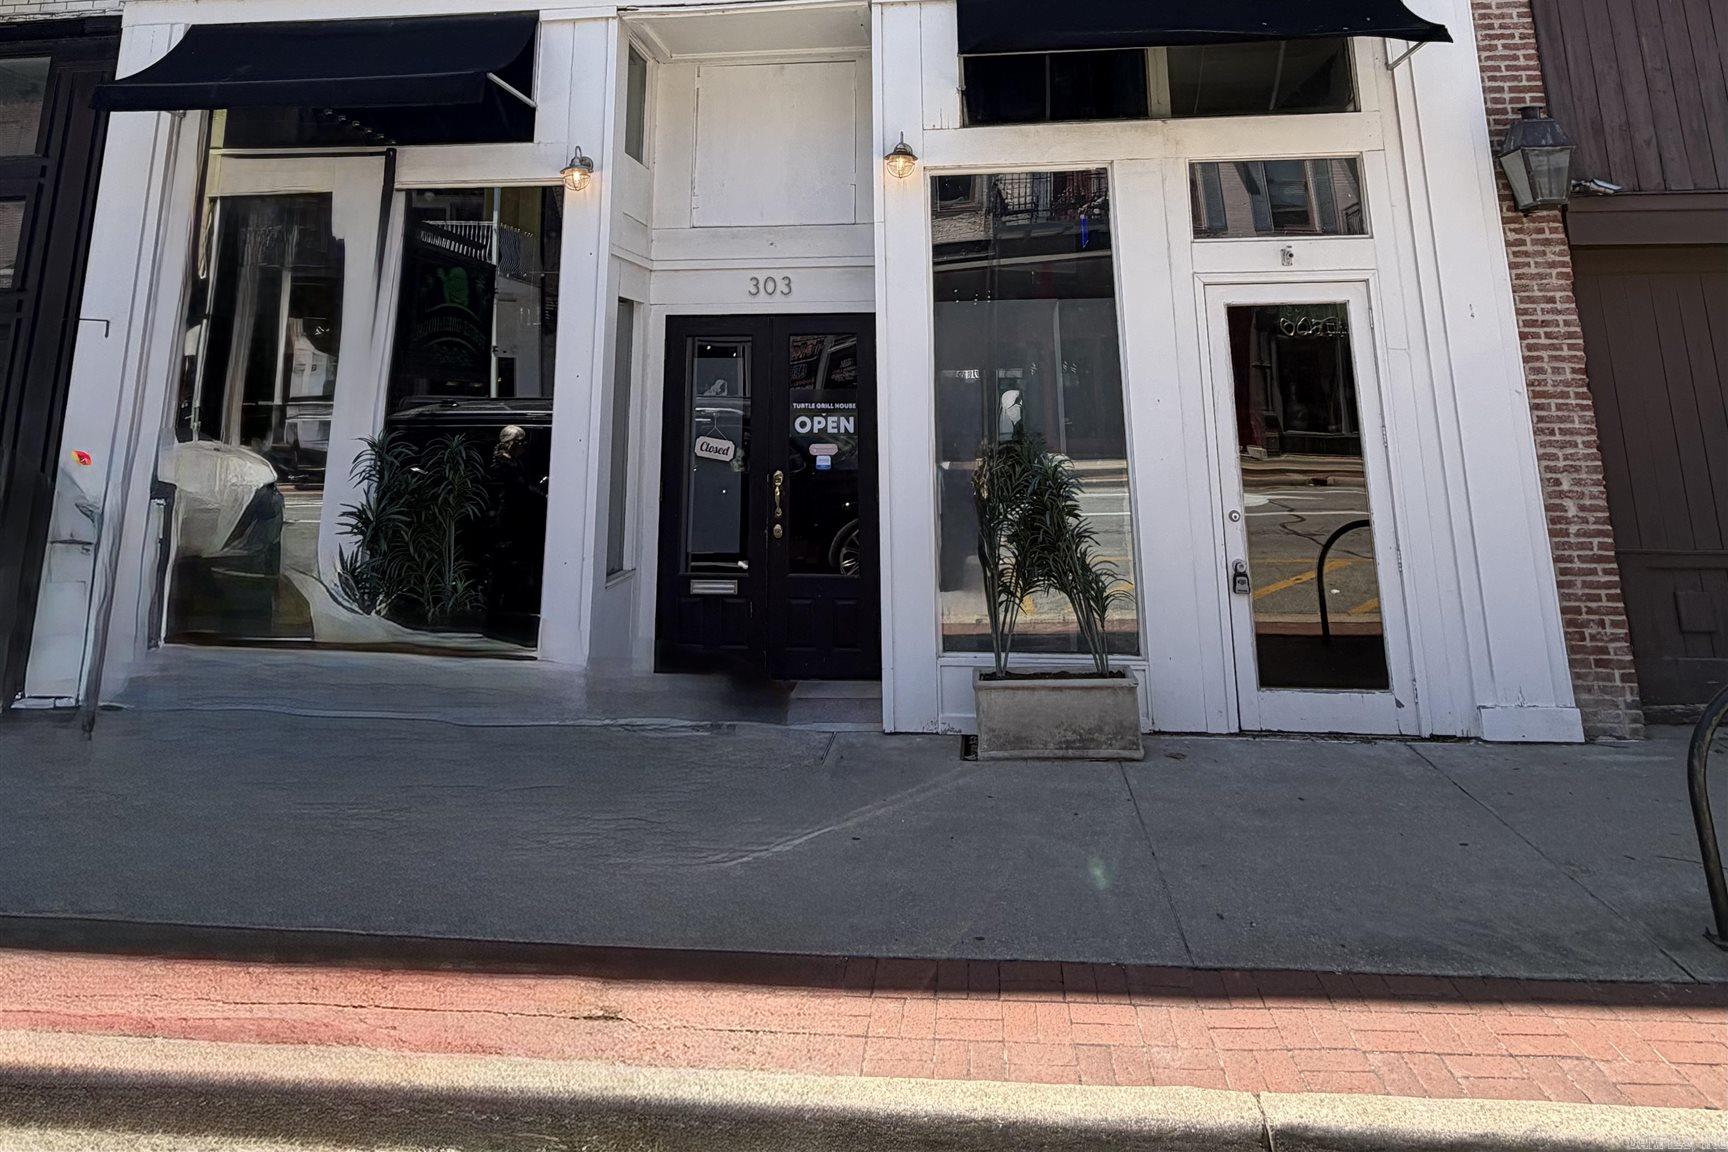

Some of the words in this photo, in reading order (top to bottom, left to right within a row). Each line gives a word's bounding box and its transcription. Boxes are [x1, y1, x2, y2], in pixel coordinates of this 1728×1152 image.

[748, 276, 792, 296] 303
[794, 415, 855, 434] OPEN
[700, 441, 730, 456] Closed
